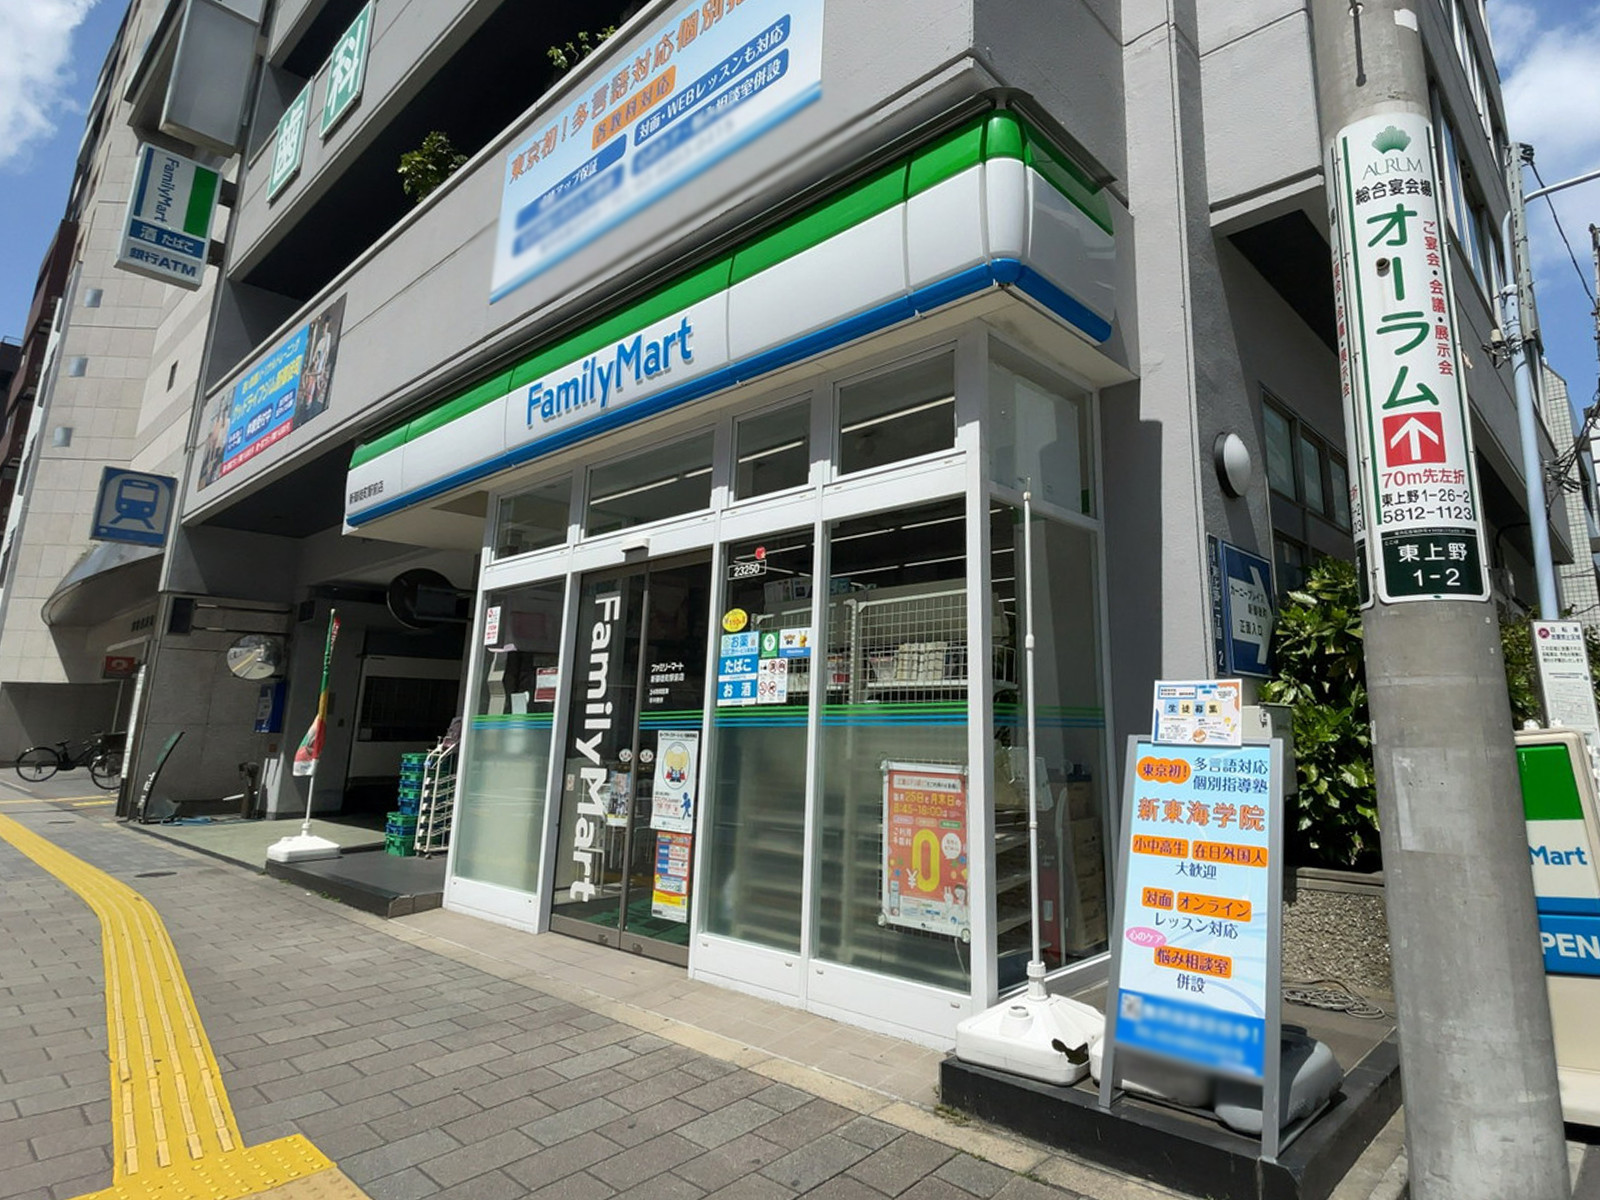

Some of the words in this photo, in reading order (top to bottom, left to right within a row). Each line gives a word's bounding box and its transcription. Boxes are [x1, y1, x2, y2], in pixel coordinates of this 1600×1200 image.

[153, 157, 180, 223] FamilyMart
[1355, 178, 1432, 205] 総合宴会場
[141, 225, 157, 242] 酒
[162, 234, 195, 254] たばこ
[129, 247, 197, 277] 銀行ATM
[1366, 203, 1439, 409] オーラム
[527, 317, 694, 426] FamilyMart
[1381, 467, 1466, 488] 70m先左折
[1381, 488, 1470, 507] 東上野1-26-2
[1383, 506, 1473, 524] 5812-1123
[1397, 542, 1468, 563] 東上野
[733, 563, 760, 577] 23250
[1412, 567, 1461, 587] 1-2
[1240, 619, 1263, 637] 正面入口
[725, 658, 752, 673] たばこ
[723, 681, 751, 698] お酒
[571, 594, 621, 902] FamilyMart
[1143, 763, 1188, 778] 東京初!
[1194, 757, 1268, 774] 多言語対応
[1193, 775, 1268, 795] 個別指導塾
[1137, 796, 1265, 832] 新東海学院
[1134, 837, 1187, 857] 小中高生
[1194, 845, 1266, 865] 在日外国人
[1175, 862, 1217, 880] 大歓迎
[1144, 890, 1173, 908] 対面
[1179, 896, 1250, 918] オンライン
[1155, 912, 1239, 940] レッスン対応
[1540, 931, 1600, 959] PEN
[1157, 949, 1229, 976] 悩み相談室
[1176, 973, 1206, 994] 併設
